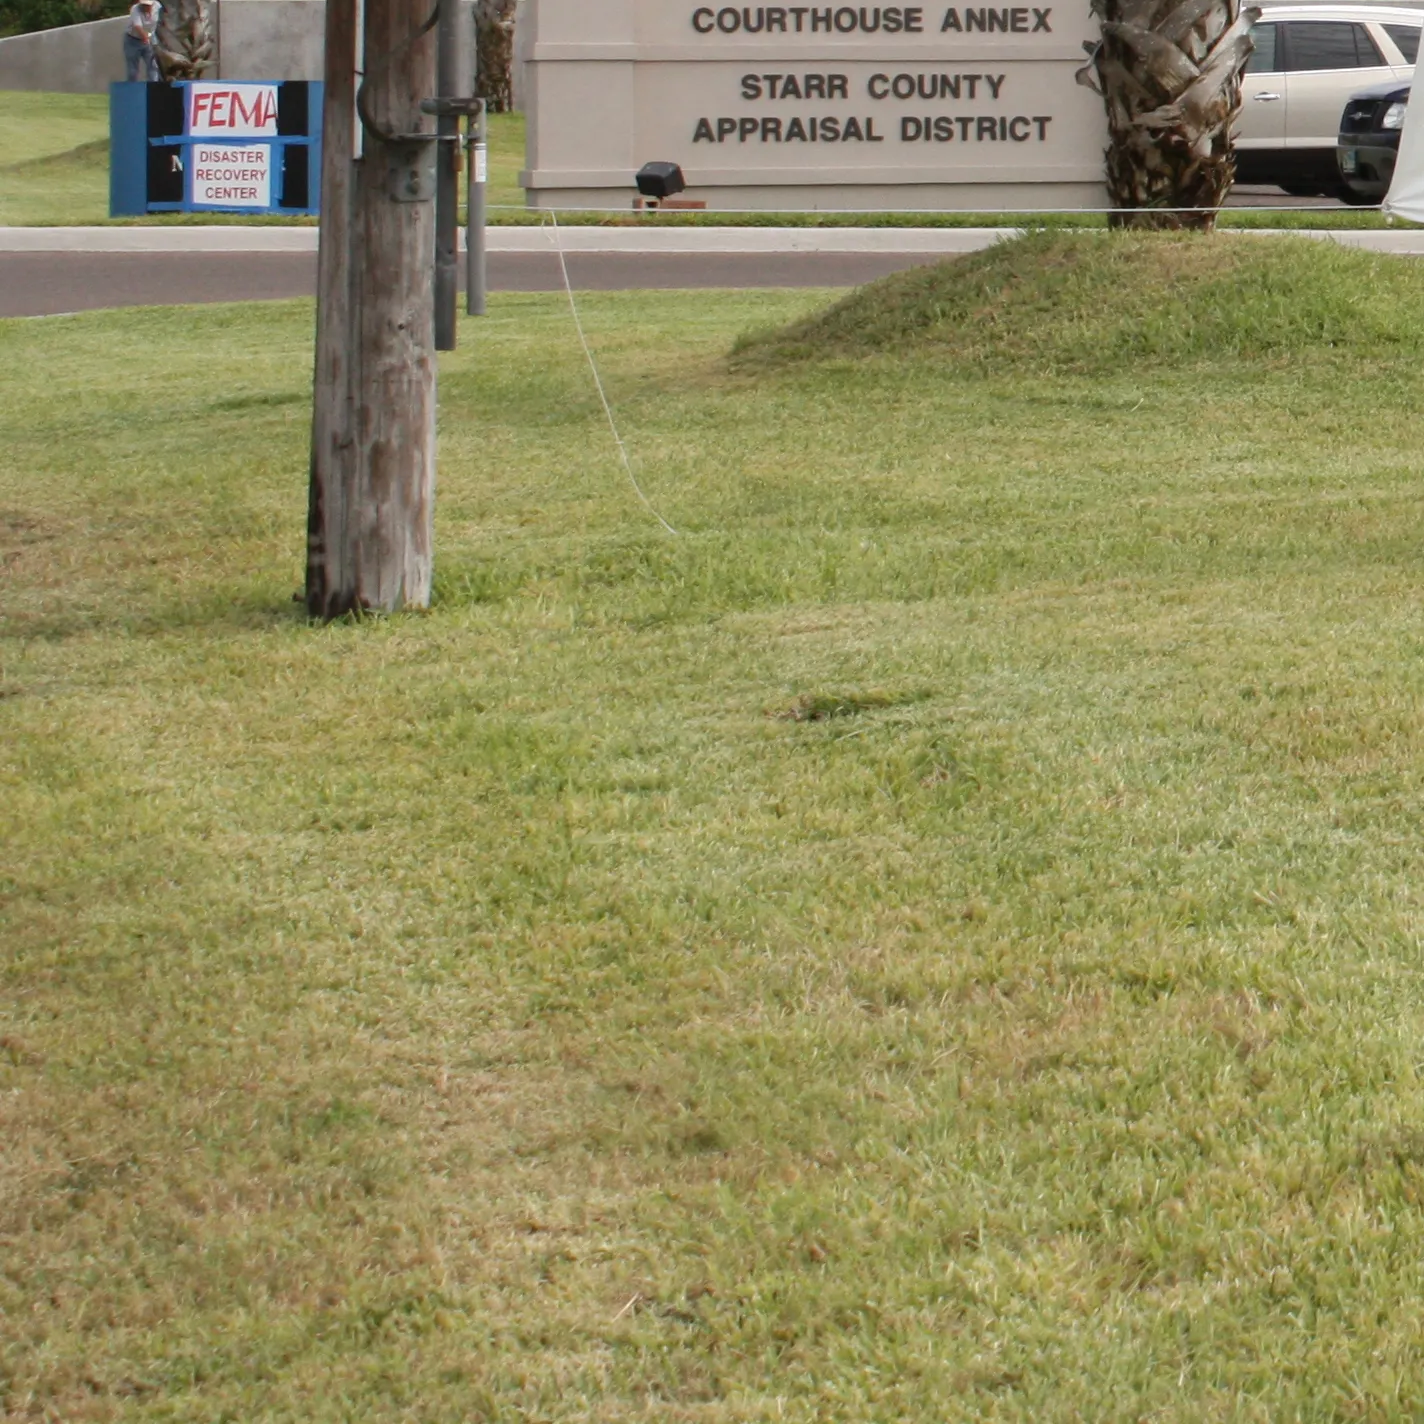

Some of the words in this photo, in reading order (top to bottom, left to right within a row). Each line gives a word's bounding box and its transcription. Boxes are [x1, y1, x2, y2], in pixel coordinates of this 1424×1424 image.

[692, 7, 923, 33] COURTHOUSE
[941, 7, 1052, 33] ANNEX
[740, 73, 849, 100] STARR
[867, 73, 1006, 100] COUNTY
[192, 90, 279, 128] FEMA
[693, 116, 884, 143] APPRAISAL
[901, 116, 1052, 142] DISTRICT
[200, 151, 264, 163] DISASTER
[196, 169, 268, 181] RECOVERY
[205, 187, 258, 199] CENTER
